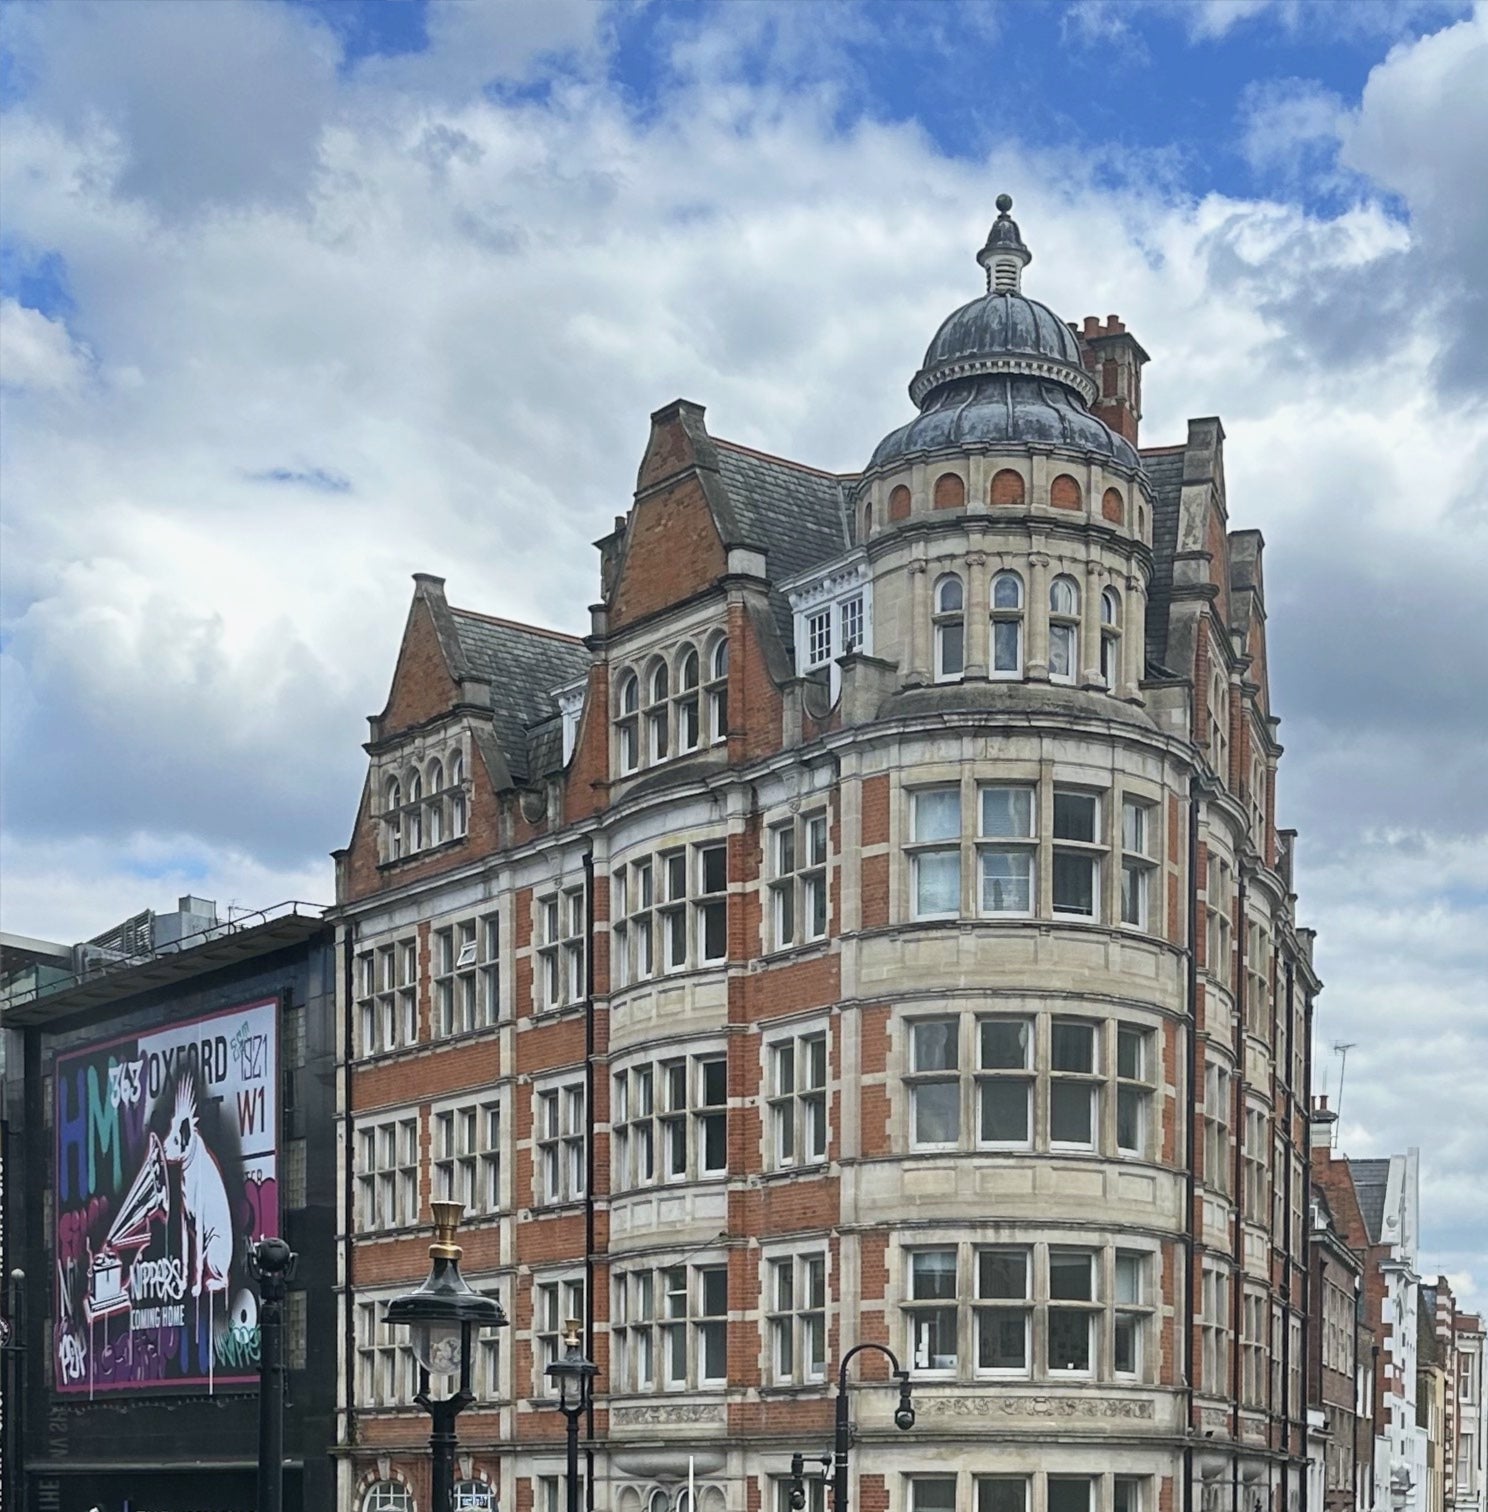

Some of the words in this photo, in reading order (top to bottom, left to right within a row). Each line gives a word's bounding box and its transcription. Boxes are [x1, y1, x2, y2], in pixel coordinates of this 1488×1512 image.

[149, 1035, 227, 1099] OXFORD
[237, 1086, 265, 1137] W1
[131, 1310, 160, 1331] COMING
[163, 1304, 185, 1328] HOME
